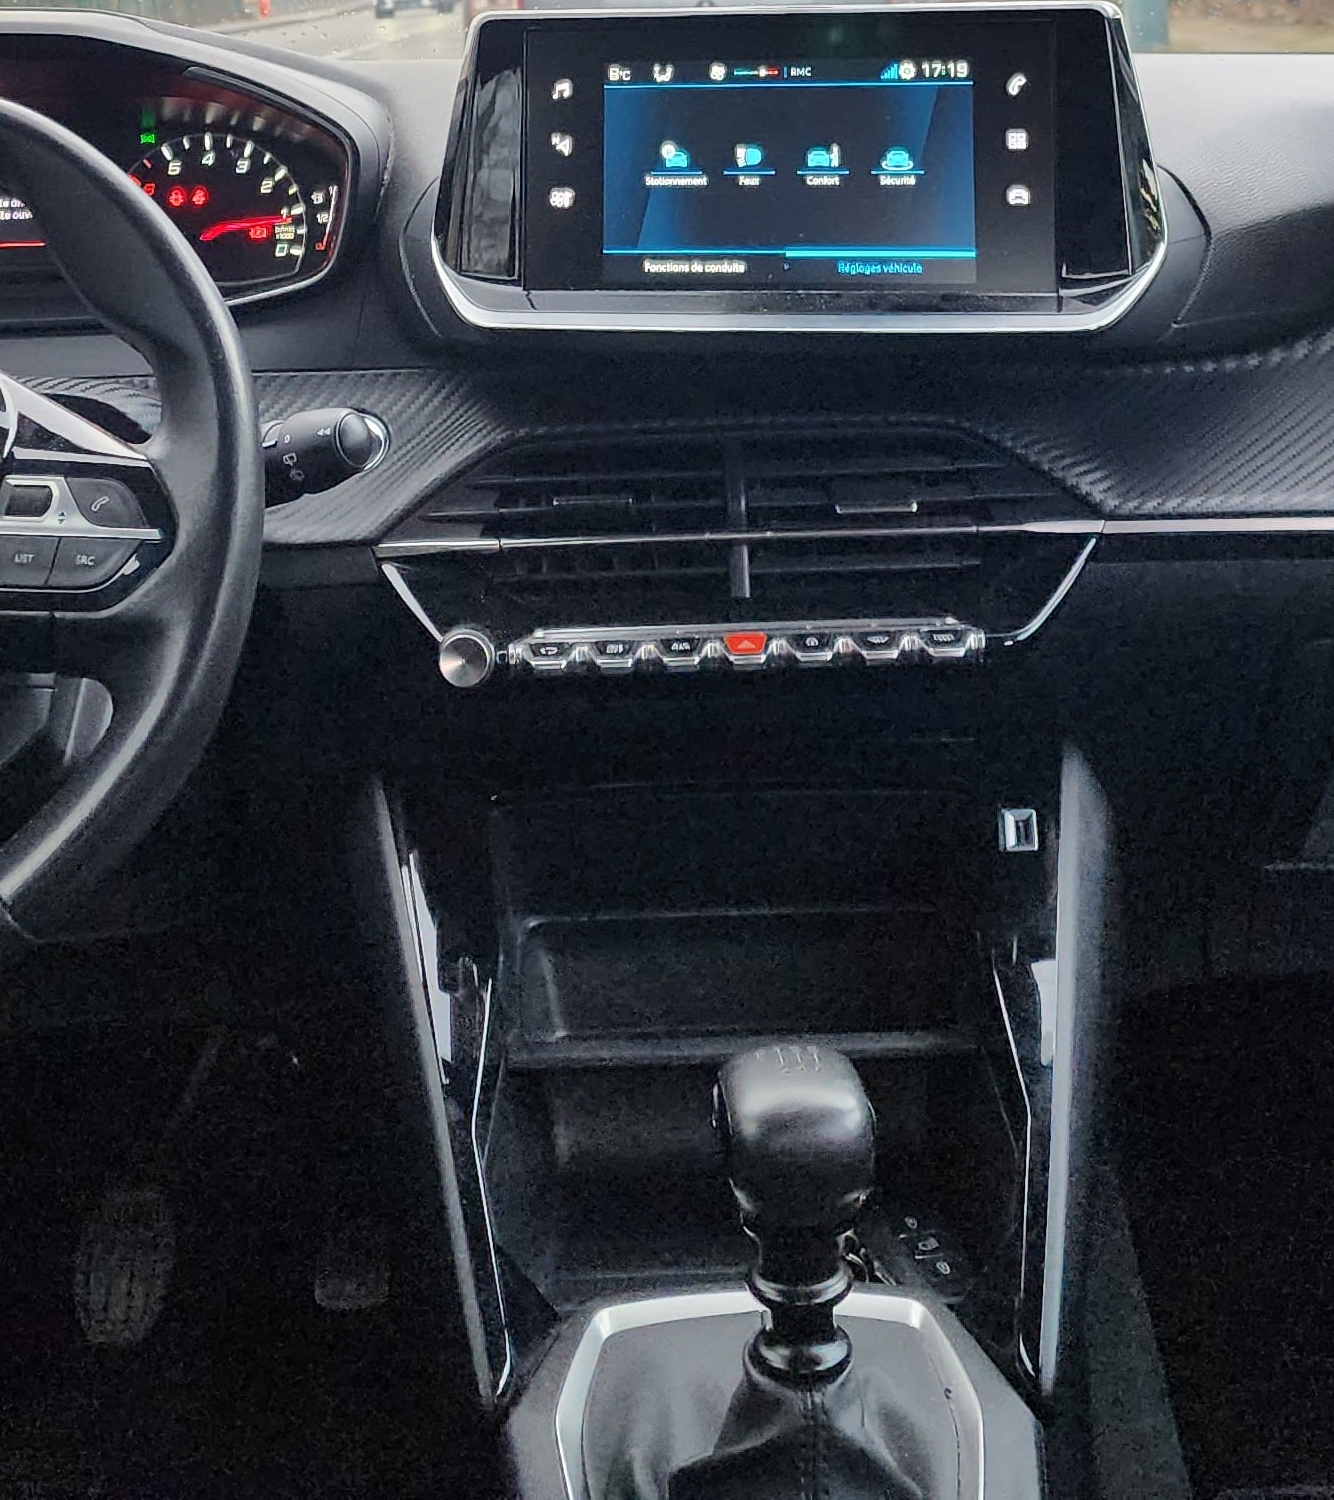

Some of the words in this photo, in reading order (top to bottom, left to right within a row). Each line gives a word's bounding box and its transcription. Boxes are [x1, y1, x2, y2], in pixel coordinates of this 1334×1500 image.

[790, 66, 812, 77] RMC
[922, 60, 969, 78] 17:19
[202, 153, 214, 166] 4
[167, 161, 181, 176] 5
[235, 160, 250, 174] 3
[259, 180, 272, 194] 2
[806, 176, 841, 187] Confort
[879, 175, 916, 187] Sécurité
[275, 243, 288, 257] 0
[644, 261, 689, 273] Fonctions
[690, 262, 704, 273] de
[704, 261, 746, 273] conduite
[14, 553, 35, 563] LIST
[75, 554, 96, 566] SRC
